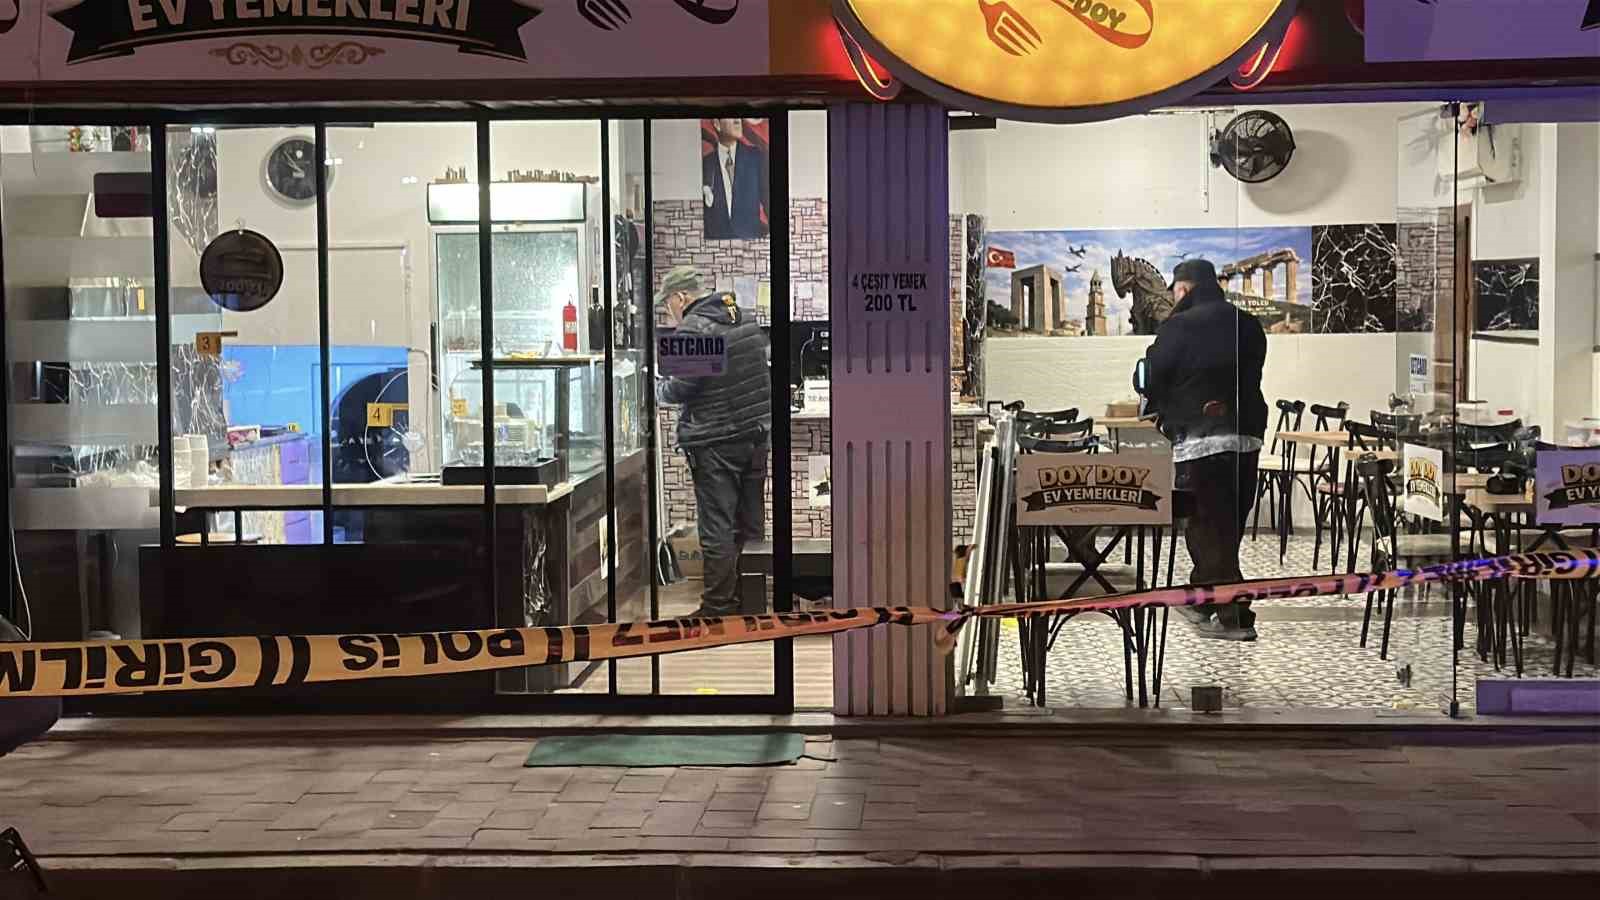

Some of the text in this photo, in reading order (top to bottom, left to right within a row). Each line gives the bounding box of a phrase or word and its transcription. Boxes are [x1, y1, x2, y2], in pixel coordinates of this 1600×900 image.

[128, 0, 186, 31] EV
[1066, 0, 1127, 30] DOY
[852, 273, 859, 289] 4
[891, 273, 927, 290] YEMEK
[865, 294, 918, 312] 200 TL
[202, 335, 210, 350] 3
[660, 336, 724, 356] SETCARD
[372, 408, 381, 422] 4
[1038, 464, 1150, 488] DOY DOY
[1043, 490, 1061, 503] EV
[1567, 486, 1600, 501] EV Y
